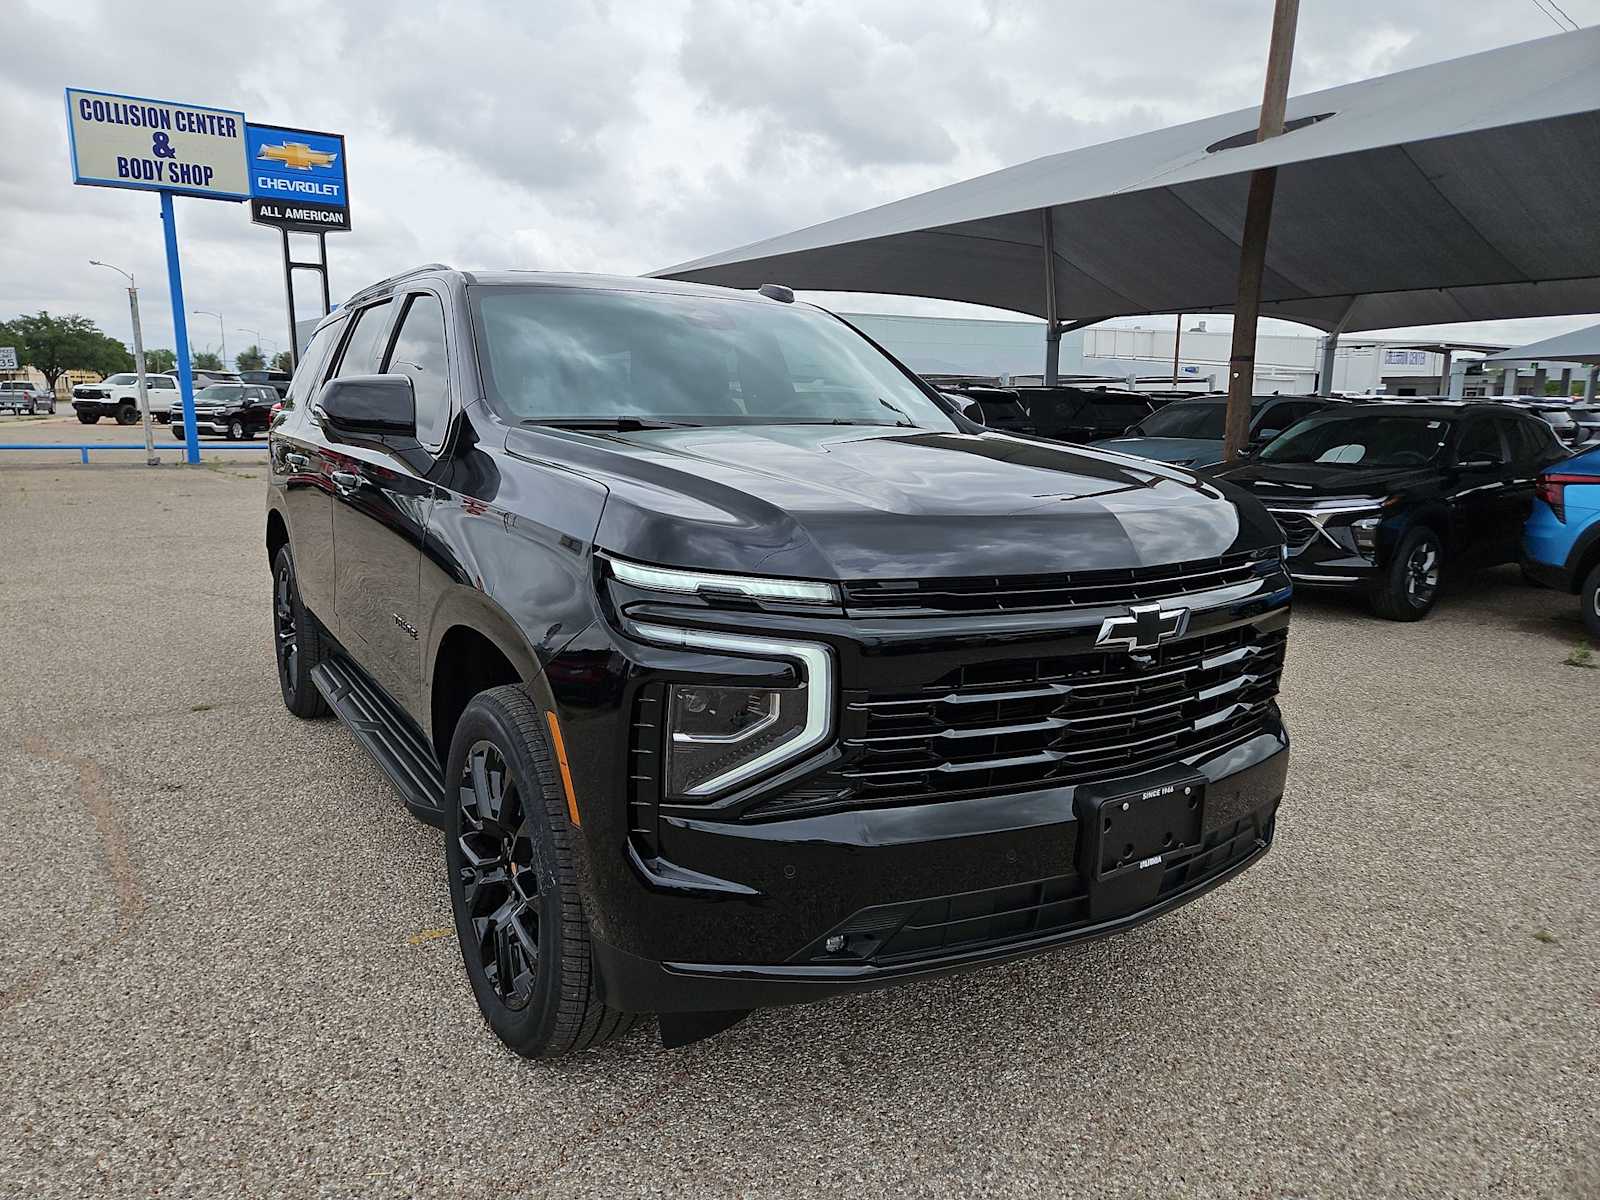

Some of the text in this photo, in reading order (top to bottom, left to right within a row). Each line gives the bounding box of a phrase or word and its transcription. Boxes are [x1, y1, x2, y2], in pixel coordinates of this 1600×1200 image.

[79, 98, 237, 138] COLLISION CENTER
[152, 131, 176, 159] &
[117, 156, 213, 187] BODY SHOP
[258, 176, 340, 196] CHEVROLET
[260, 205, 344, 224] ALL AMERICAN
[0, 358, 15, 367] 35
[1142, 789, 1161, 800] SINCE
